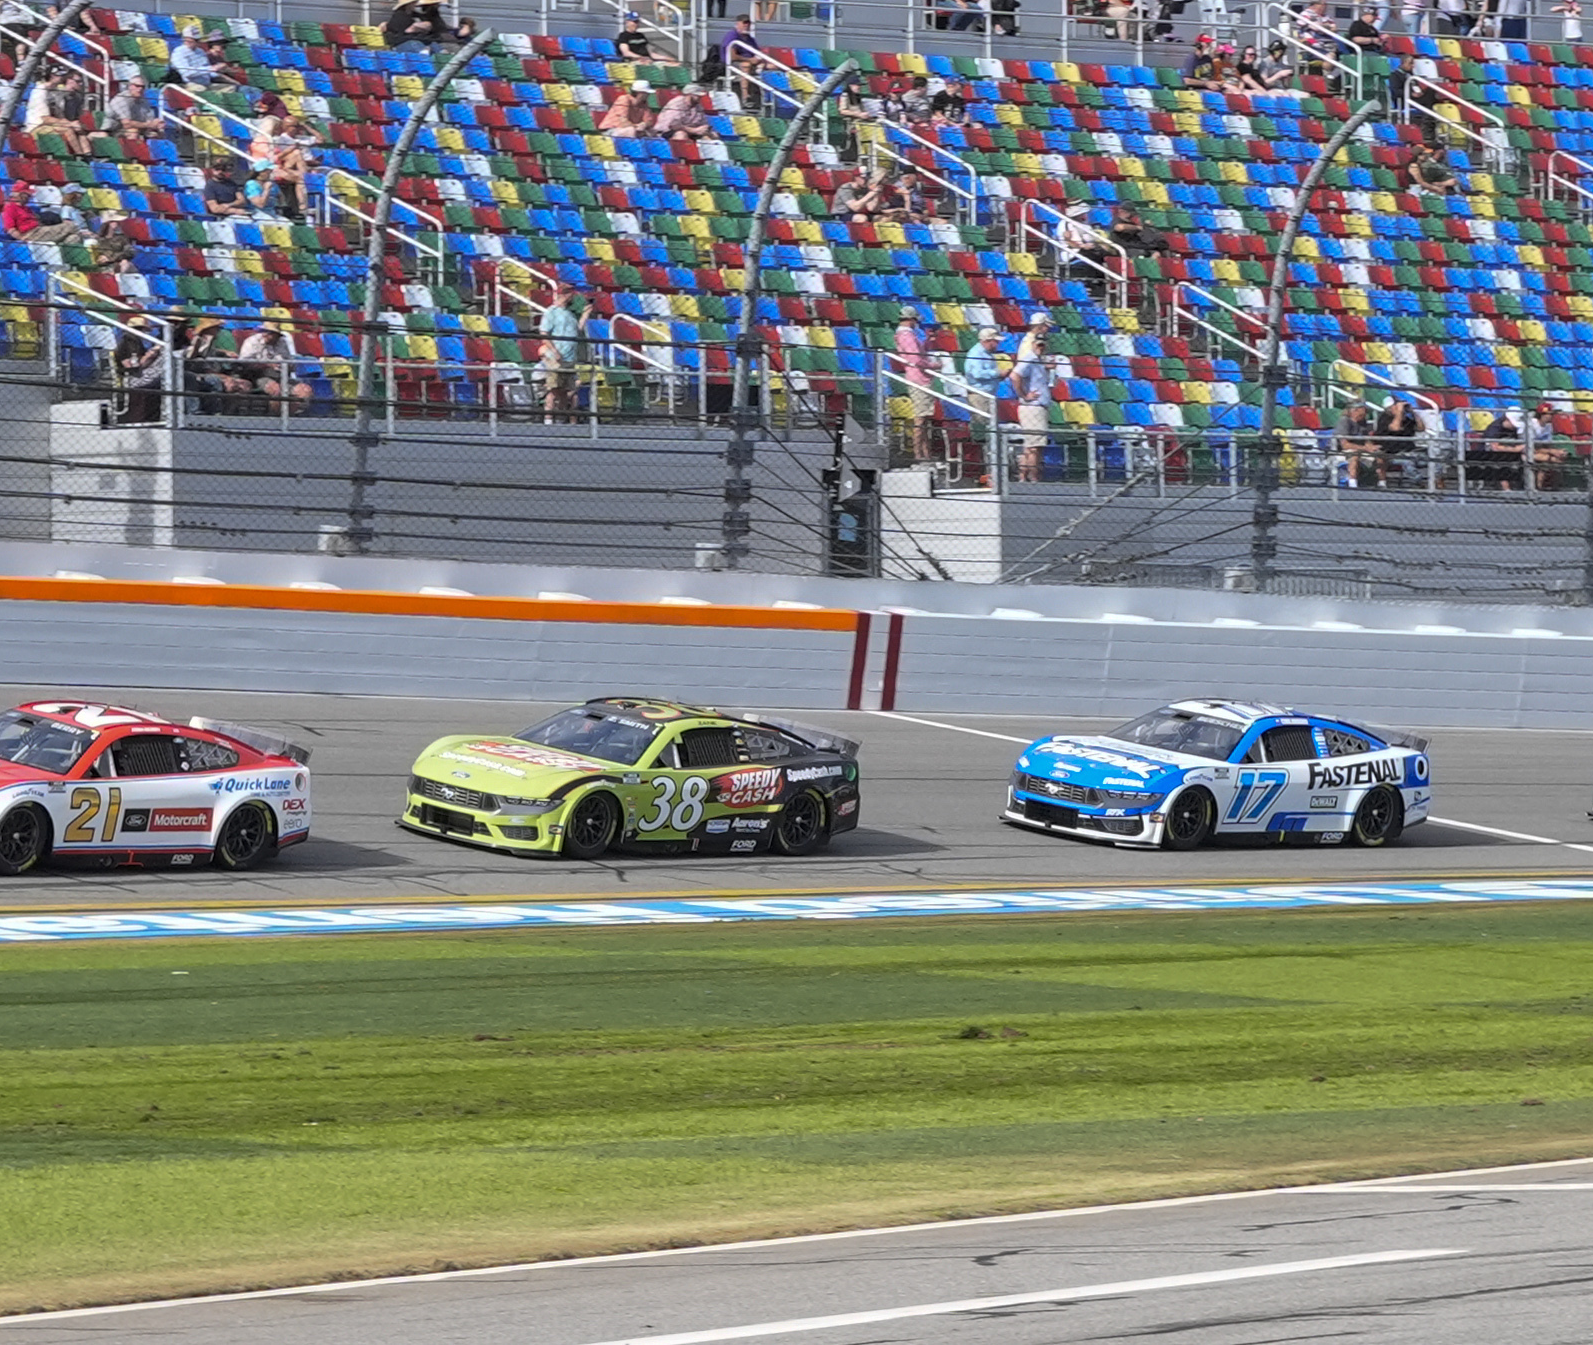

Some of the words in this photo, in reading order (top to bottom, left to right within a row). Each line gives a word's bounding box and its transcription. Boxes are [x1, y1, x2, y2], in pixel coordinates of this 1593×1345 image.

[50, 721, 85, 735] BERRY
[618, 717, 649, 731] SMITH
[731, 768, 782, 792] SPEEDY
[787, 766, 843, 782] SpeedyCash.com
[1308, 757, 1401, 791] FASTENAL
[224, 777, 262, 792] Quick
[264, 777, 291, 791] Lane
[638, 775, 709, 832] 38
[1222, 768, 1290, 824] 17
[283, 799, 305, 810] DEX
[64, 787, 122, 842] 21
[154, 812, 208, 826] Motorcraft
[732, 839, 756, 849] FORD
